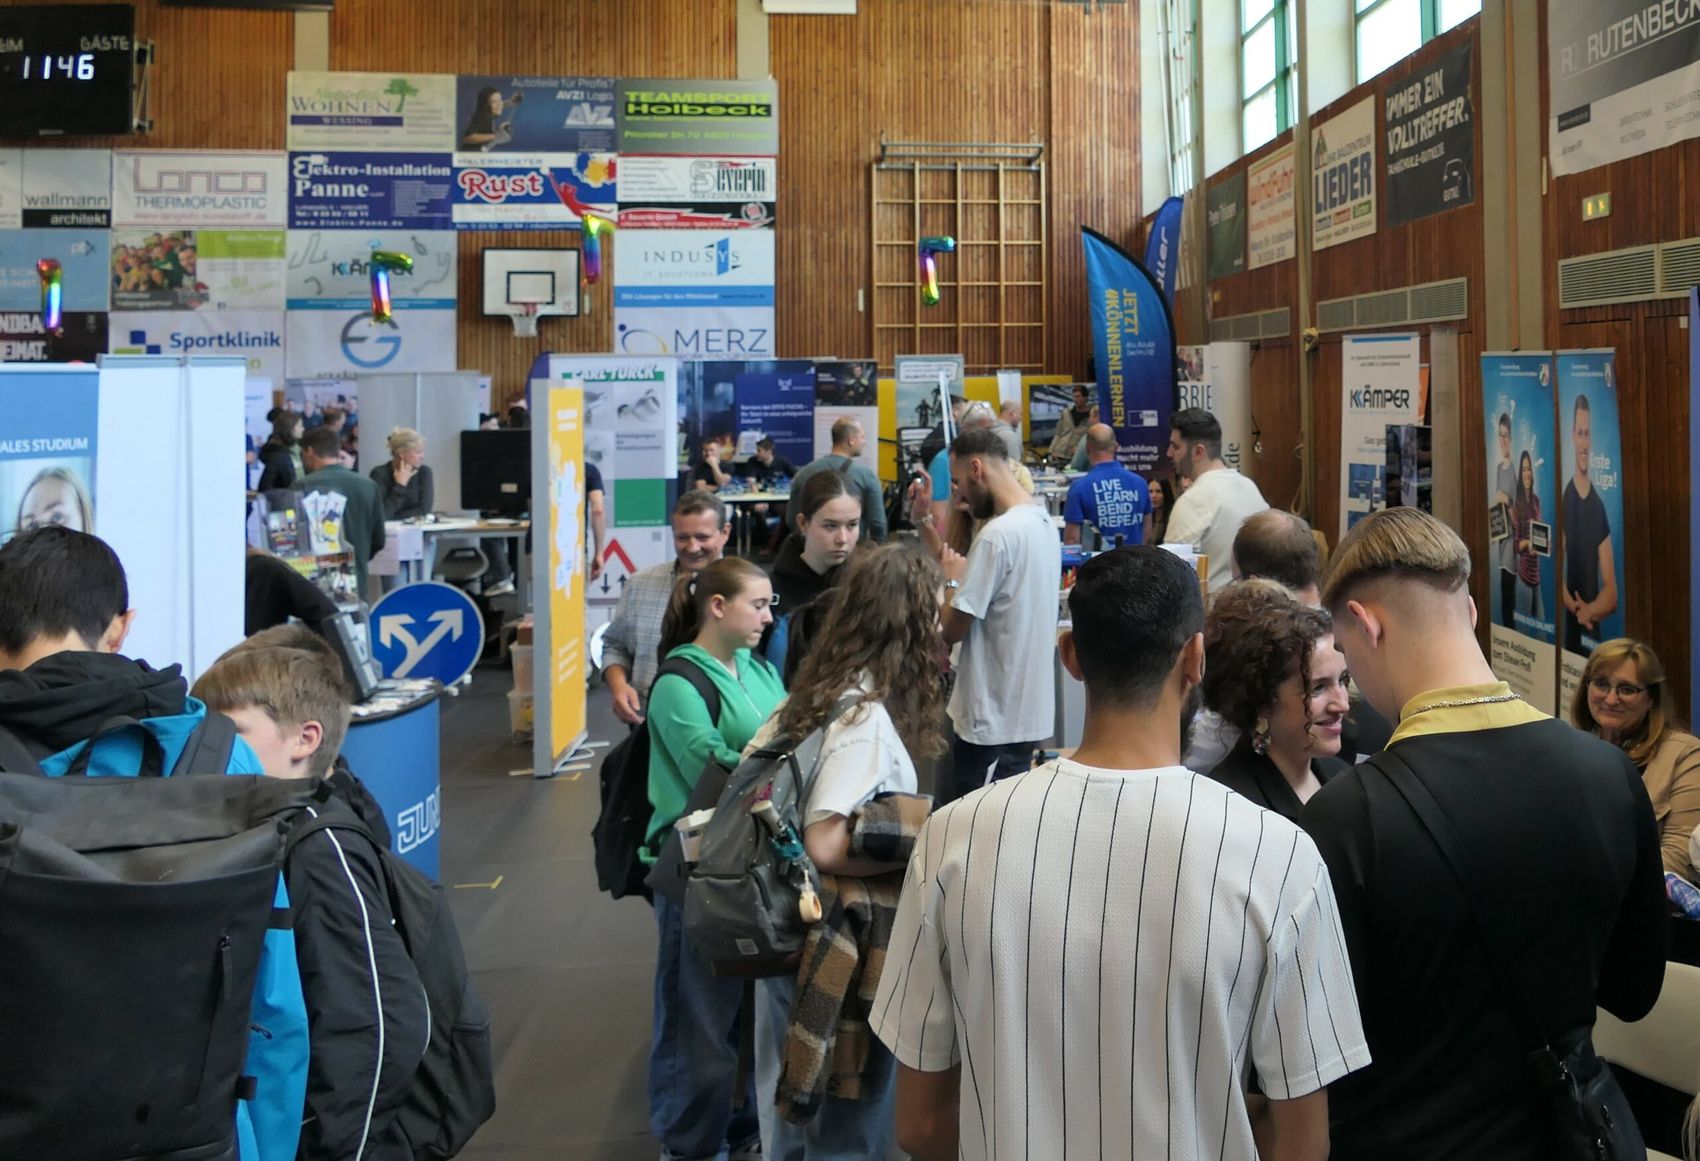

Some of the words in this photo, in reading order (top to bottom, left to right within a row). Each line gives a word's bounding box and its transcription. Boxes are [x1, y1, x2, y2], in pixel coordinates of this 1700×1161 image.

[625, 91, 770, 104] TEAMSPORT
[1386, 82, 1422, 122] IMMER
[1424, 68, 1444, 104] EIN
[291, 96, 390, 113] WOHNEN
[627, 103, 768, 116] Holbeck
[1387, 96, 1469, 155] VOLLTREFFER.
[293, 154, 451, 179] Elektro-Installation
[295, 180, 369, 198] Panne
[458, 169, 543, 202] Rust
[1315, 151, 1372, 214] LIEDER
[25, 192, 108, 206] wallmann
[134, 196, 267, 209] THERMOPLASTIC
[50, 212, 108, 226] architekt
[643, 249, 740, 264] INDUSYS
[1122, 288, 1139, 336] JETZT
[170, 330, 281, 352] Sportklinik
[675, 328, 767, 353] MERZ
[1104, 288, 1125, 428] #KÖNNENLERNEN
[1350, 384, 1409, 409] KÄMPER
[0, 439, 30, 453] ALES
[32, 438, 88, 452] STUDIUM
[1093, 479, 1122, 494] LIVE
[1595, 471, 1617, 490] Liga!
[1095, 490, 1139, 504] LEARN
[1097, 503, 1133, 517] BEND
[1099, 512, 1144, 528] REPEAT
